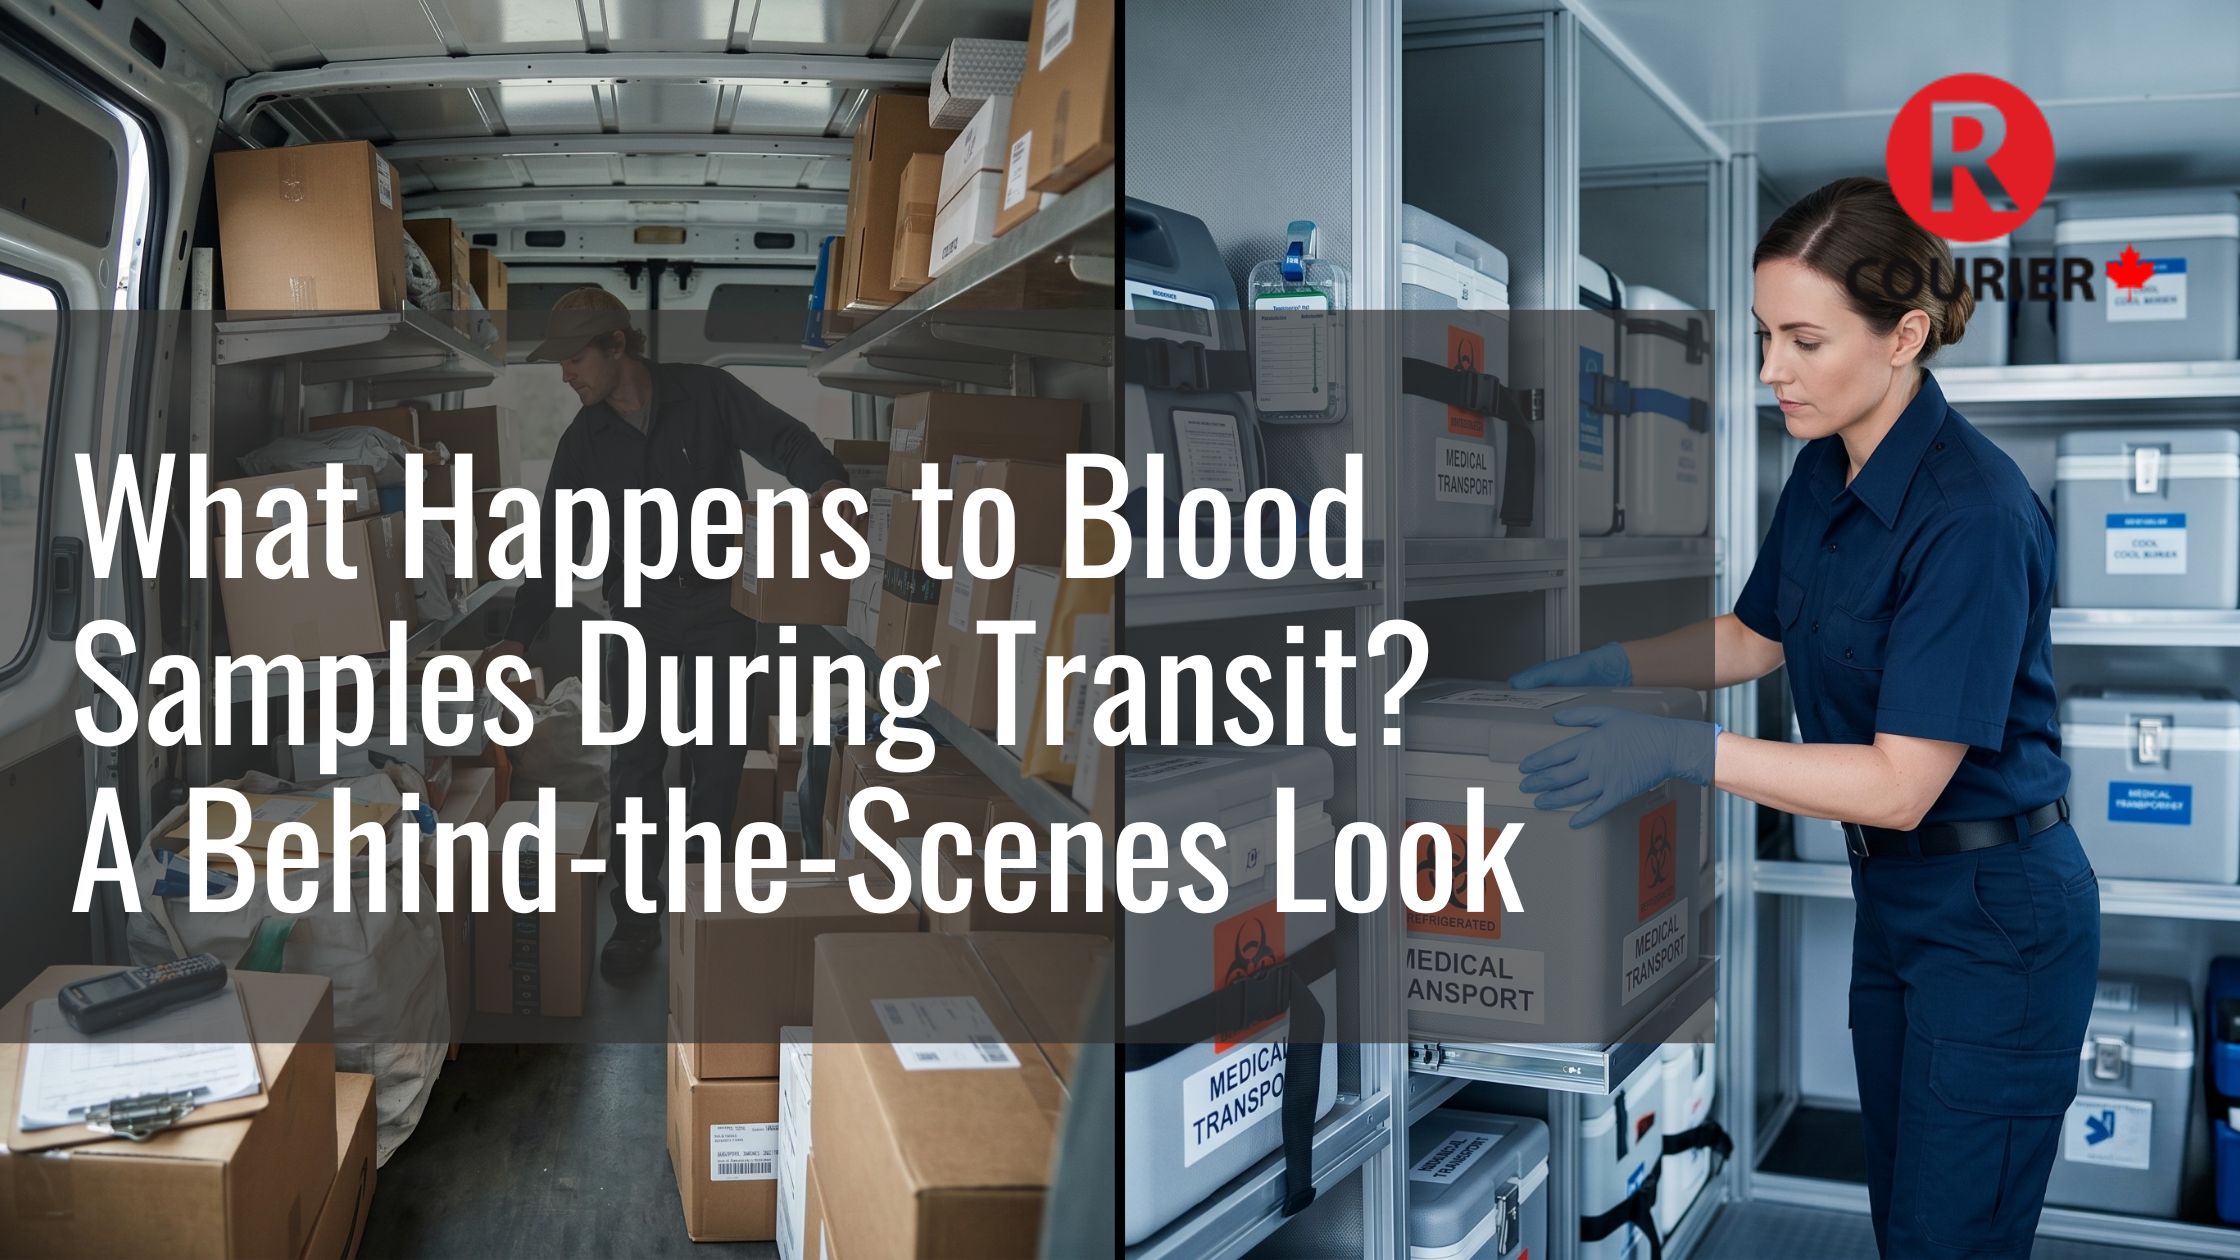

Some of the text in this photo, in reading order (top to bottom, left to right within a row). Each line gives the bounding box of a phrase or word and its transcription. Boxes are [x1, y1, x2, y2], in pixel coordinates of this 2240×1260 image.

[1446, 448, 1487, 471] MEDICAL
[1438, 474, 1494, 497] TRANSPORT
[1407, 913, 1496, 932] REFRIGERATED
[1635, 914, 1679, 959] MEDICAL
[1626, 934, 1686, 993] TRANSPORT
[1407, 978, 1535, 1012] ANSPORT
[1210, 1036, 1288, 1102] MEDICAL
[1193, 1072, 1284, 1145] TRANSPO
